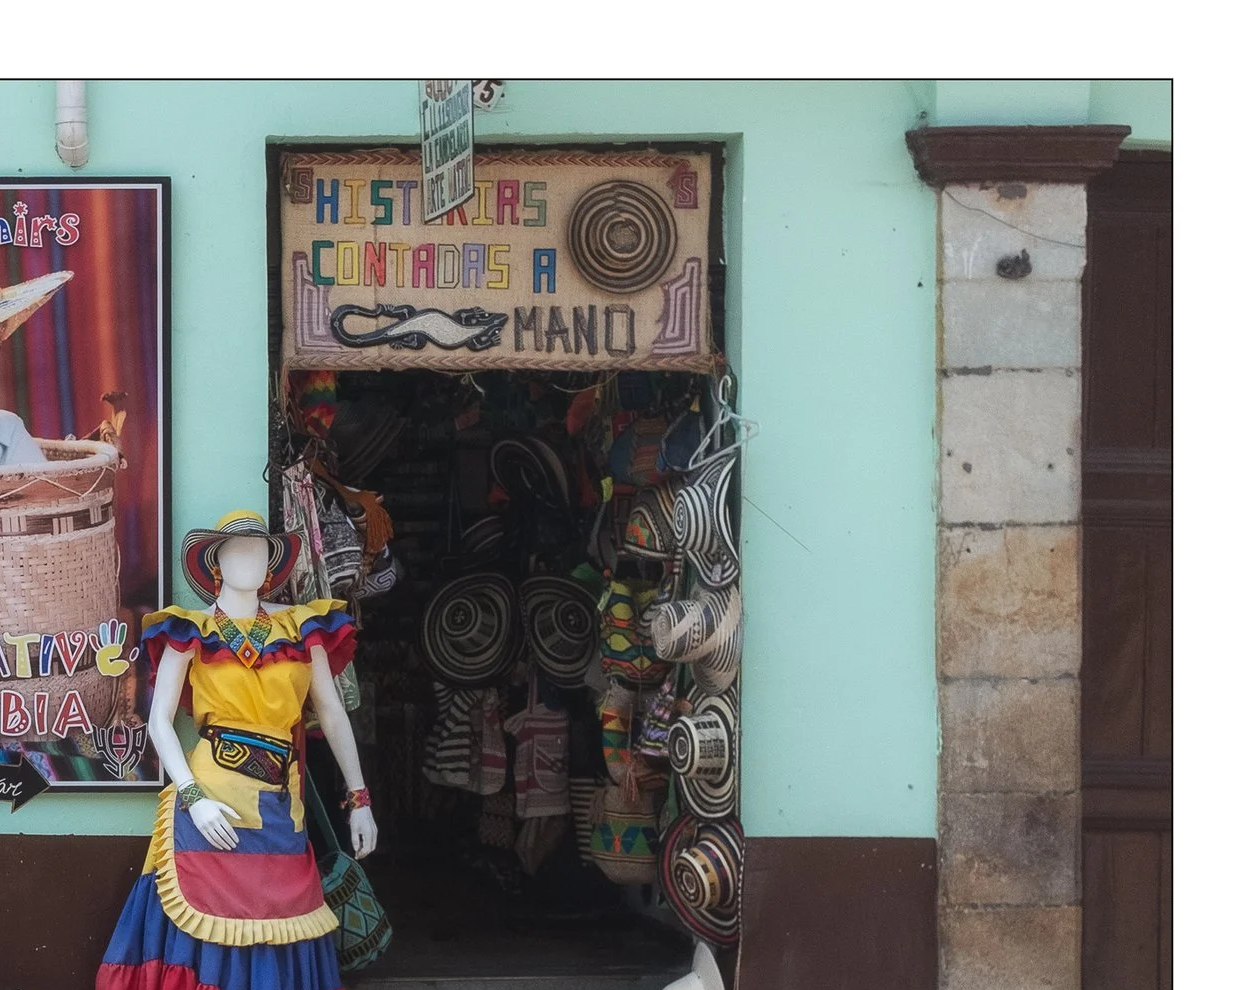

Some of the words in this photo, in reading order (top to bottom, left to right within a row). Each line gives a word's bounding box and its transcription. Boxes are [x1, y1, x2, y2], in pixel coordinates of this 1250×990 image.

[315, 178, 547, 227] HISTIAS
[312, 240, 510, 289] CONTADAS
[533, 248, 557, 293] A
[514, 304, 636, 357] MANO
